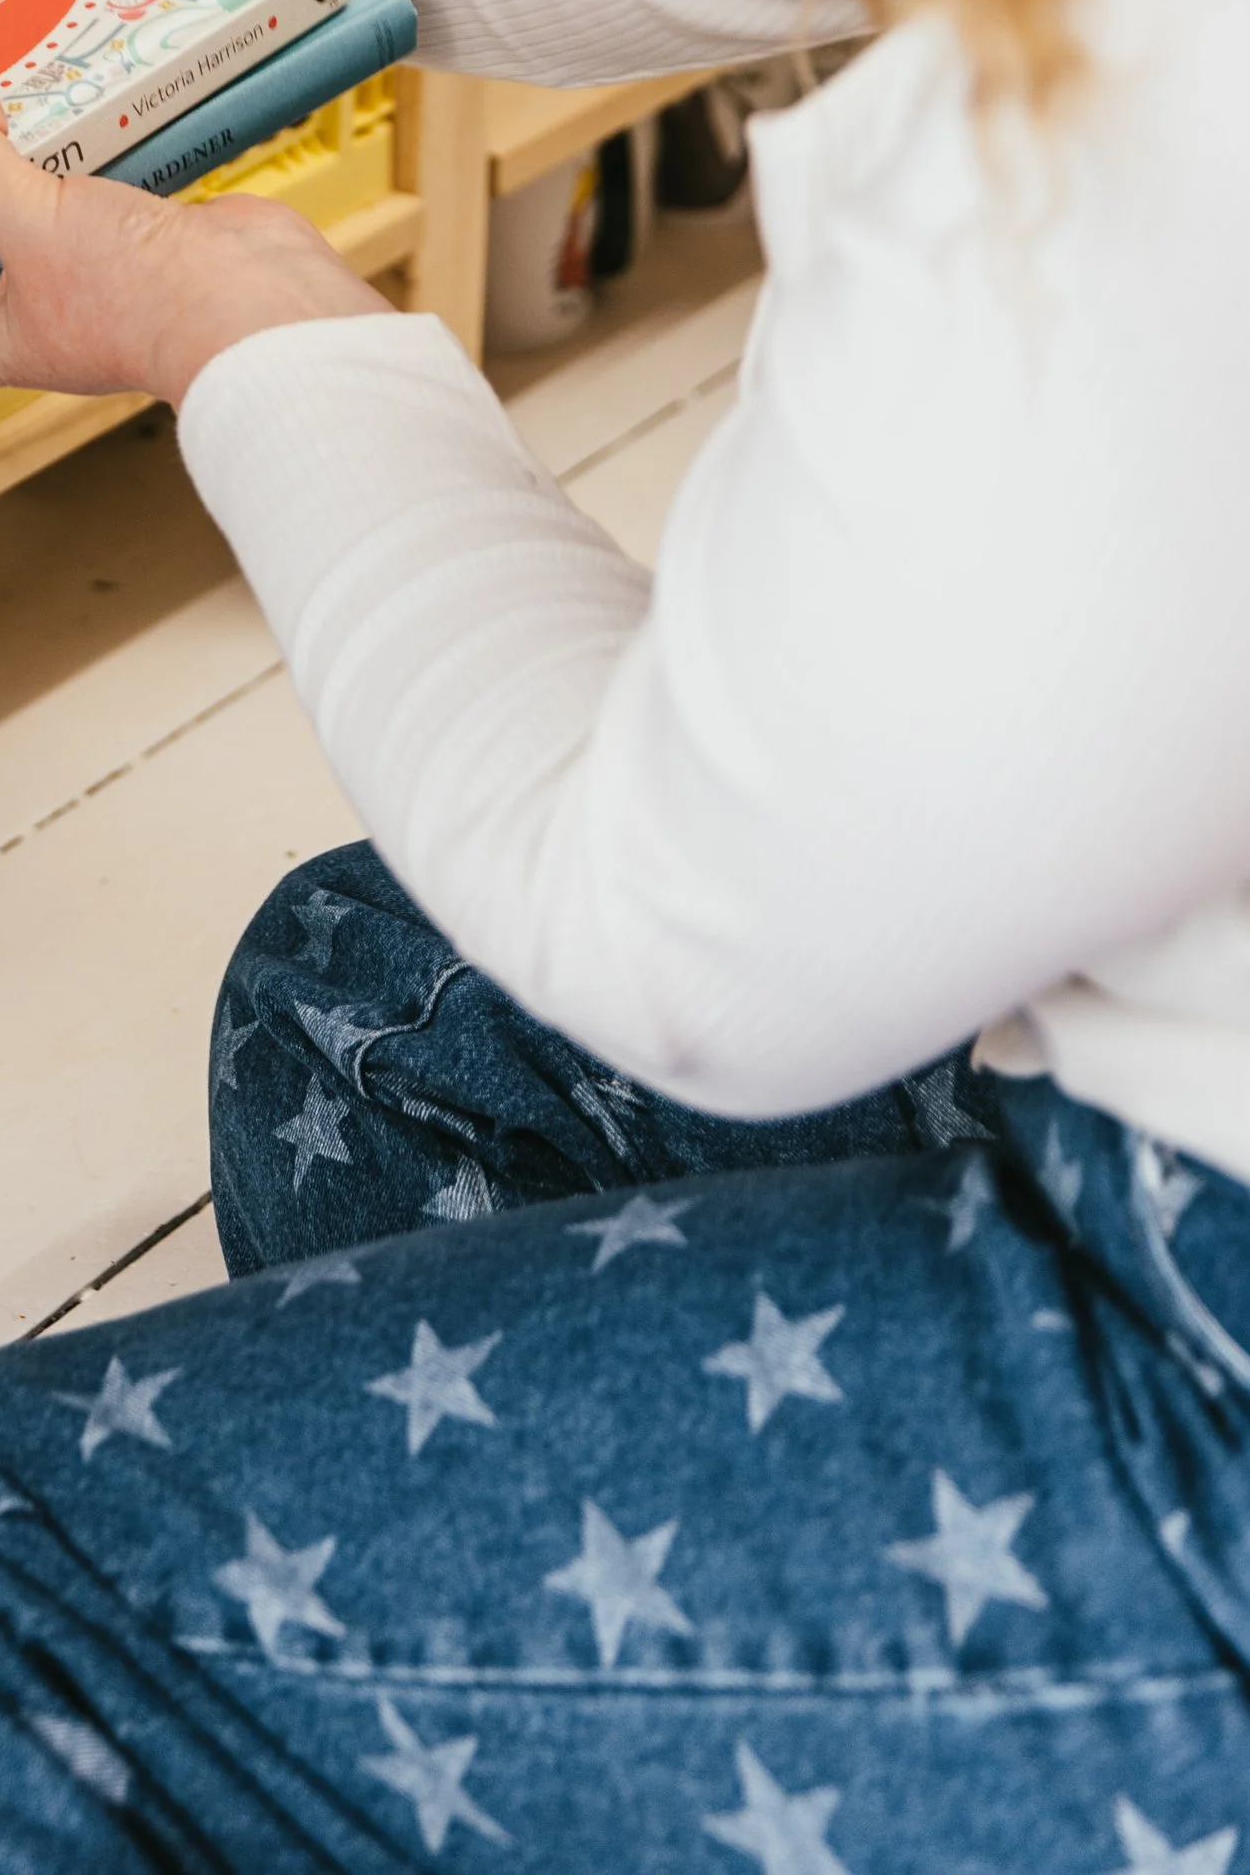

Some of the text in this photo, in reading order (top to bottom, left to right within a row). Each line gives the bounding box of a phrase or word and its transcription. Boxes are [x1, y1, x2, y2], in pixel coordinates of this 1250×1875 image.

[132, 22, 264, 117] Victoria Harrison
[140, 128, 235, 192] ARDENER
